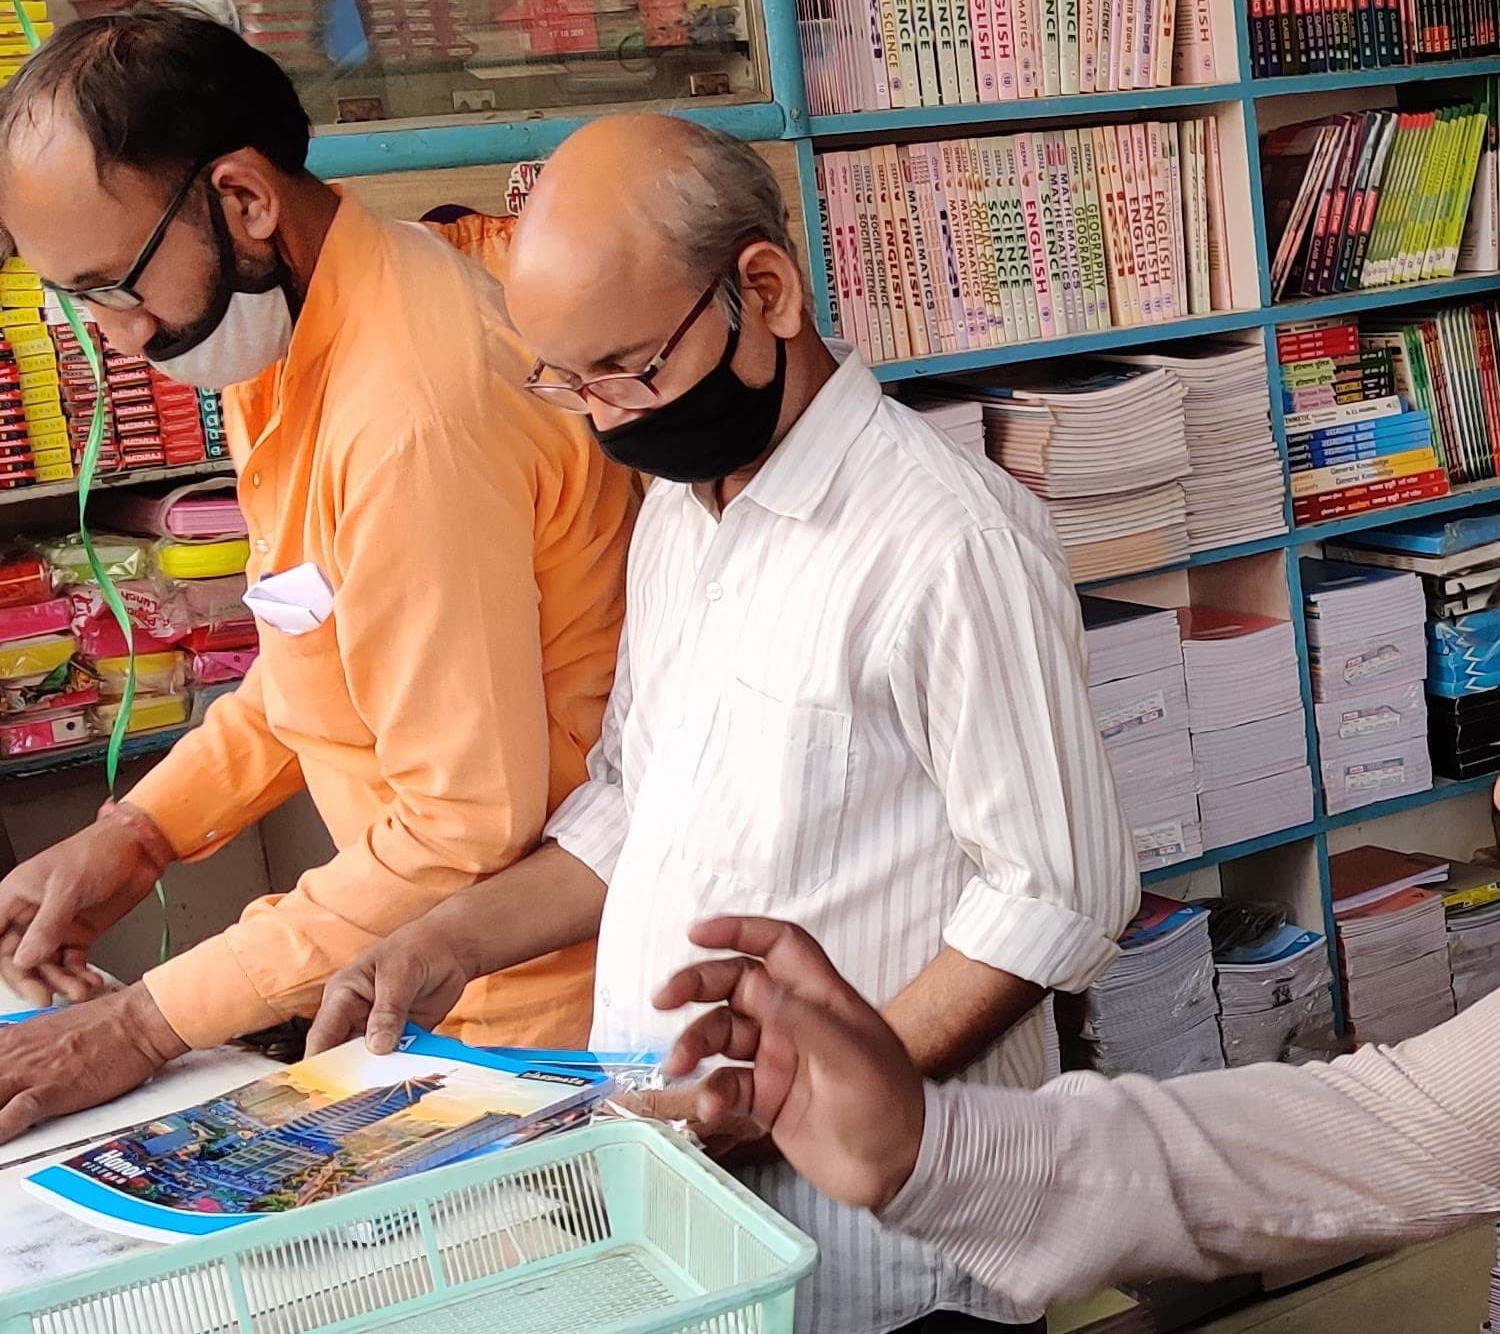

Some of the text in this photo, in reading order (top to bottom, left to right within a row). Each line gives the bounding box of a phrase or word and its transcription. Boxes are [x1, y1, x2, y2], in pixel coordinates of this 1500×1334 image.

[883, 12, 898, 67] SCIENCE
[1074, 206, 1094, 291] GEOGRAPHY
[1087, 204, 1105, 288] GEOGRAPHY
[106, 354, 145, 367] NATARAJ
[109, 371, 150, 382] NATARAJ
[1336, 475, 1360, 485] General
[119, 590, 158, 610] Lunch
[94, 1148, 153, 1180] Hanoi
